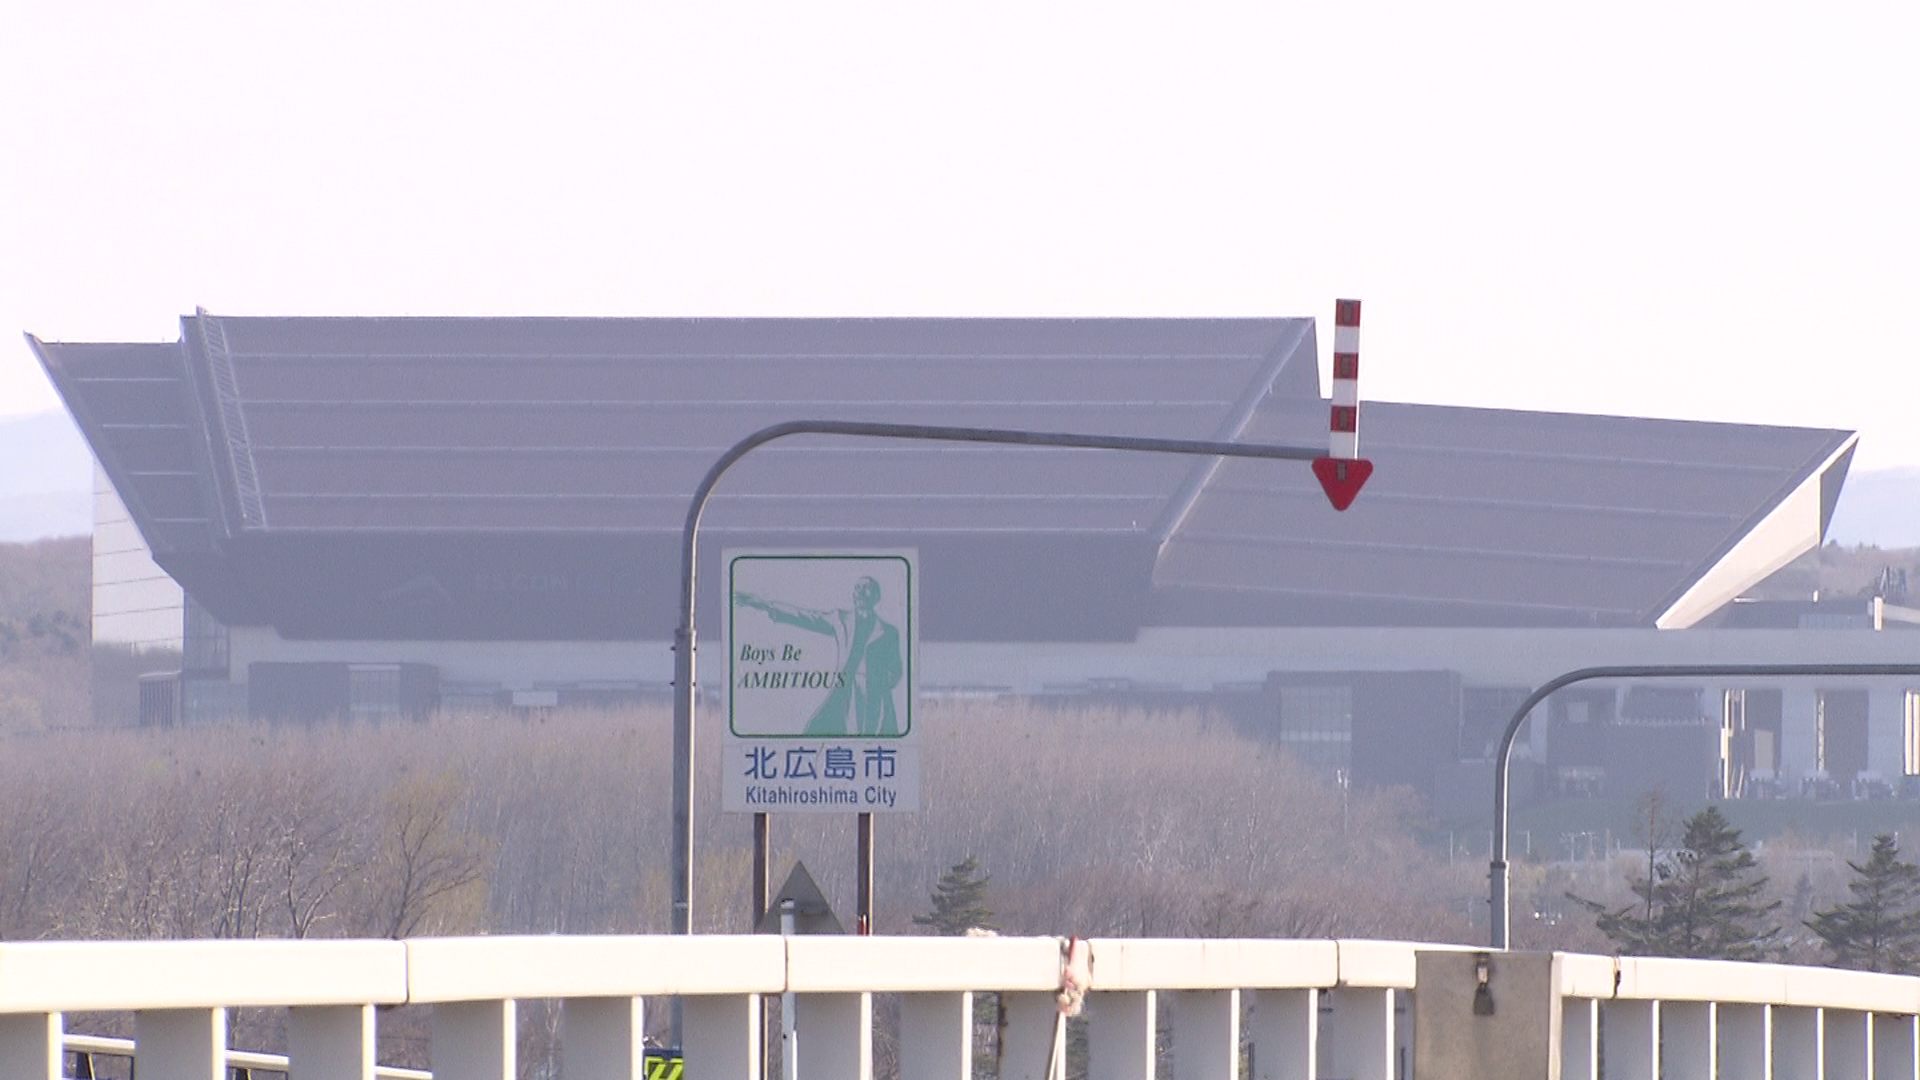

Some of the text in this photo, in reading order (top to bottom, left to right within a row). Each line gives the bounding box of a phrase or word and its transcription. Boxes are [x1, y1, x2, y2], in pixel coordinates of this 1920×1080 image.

[740, 644, 802, 666] Boys Be
[737, 671, 847, 689] AMBITIOUS
[744, 746, 898, 780] 北広島市
[745, 785, 897, 808] Kitahiroshima City
